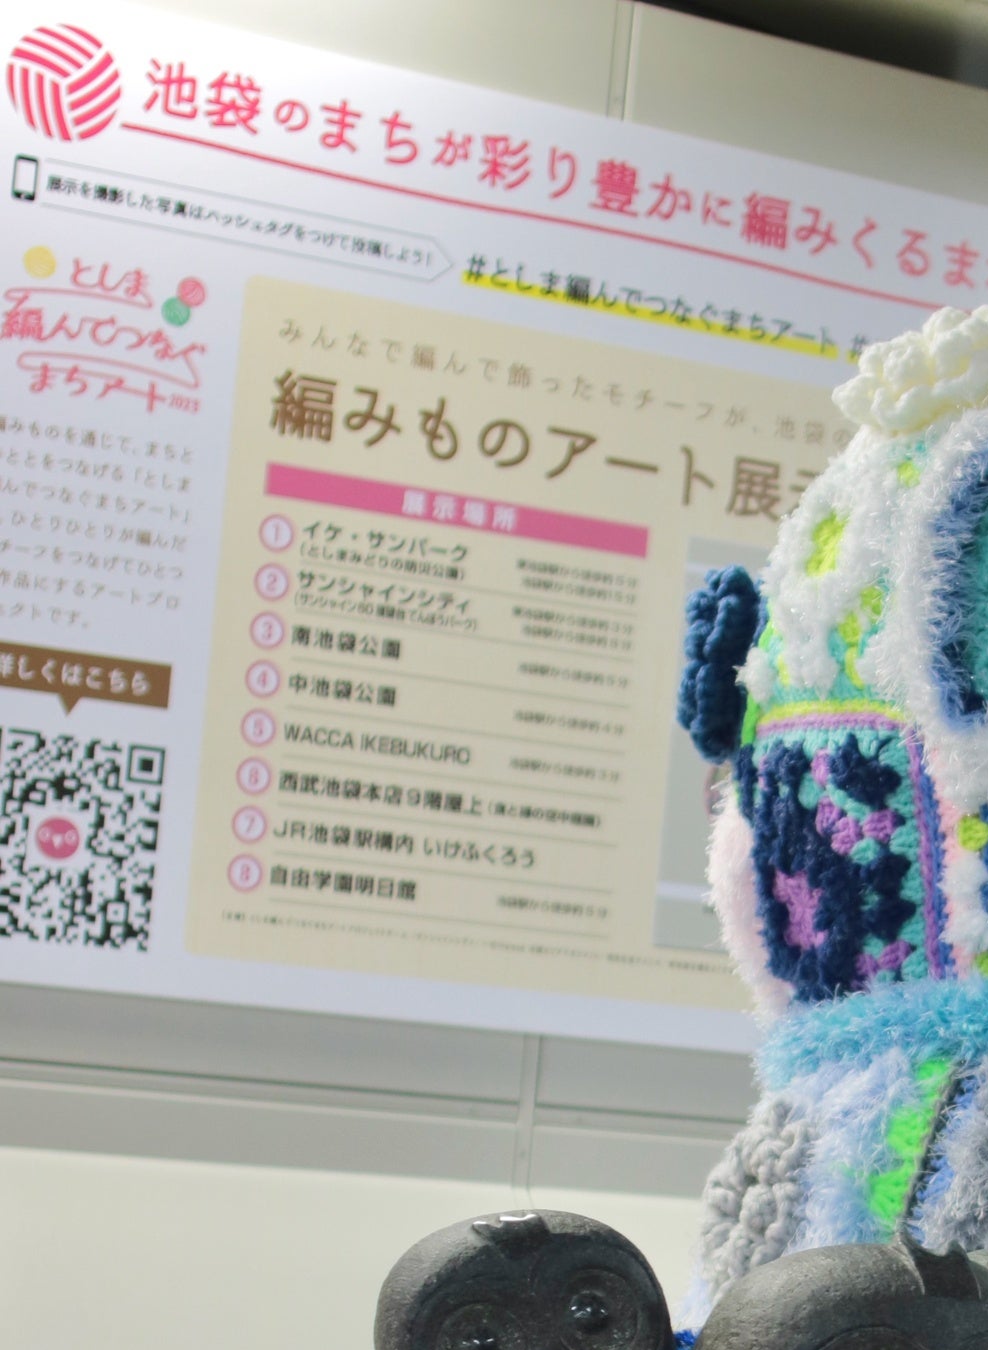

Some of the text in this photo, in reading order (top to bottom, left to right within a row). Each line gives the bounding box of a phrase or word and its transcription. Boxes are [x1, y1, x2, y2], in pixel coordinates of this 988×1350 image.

[71, 258, 149, 298] としま
[402, 489, 519, 532] 展示場所
[290, 624, 402, 660] 南池袋公園
[288, 673, 398, 708] 中池袋公園
[284, 722, 355, 751] WACCA
[361, 732, 472, 766] IKEBUKURO
